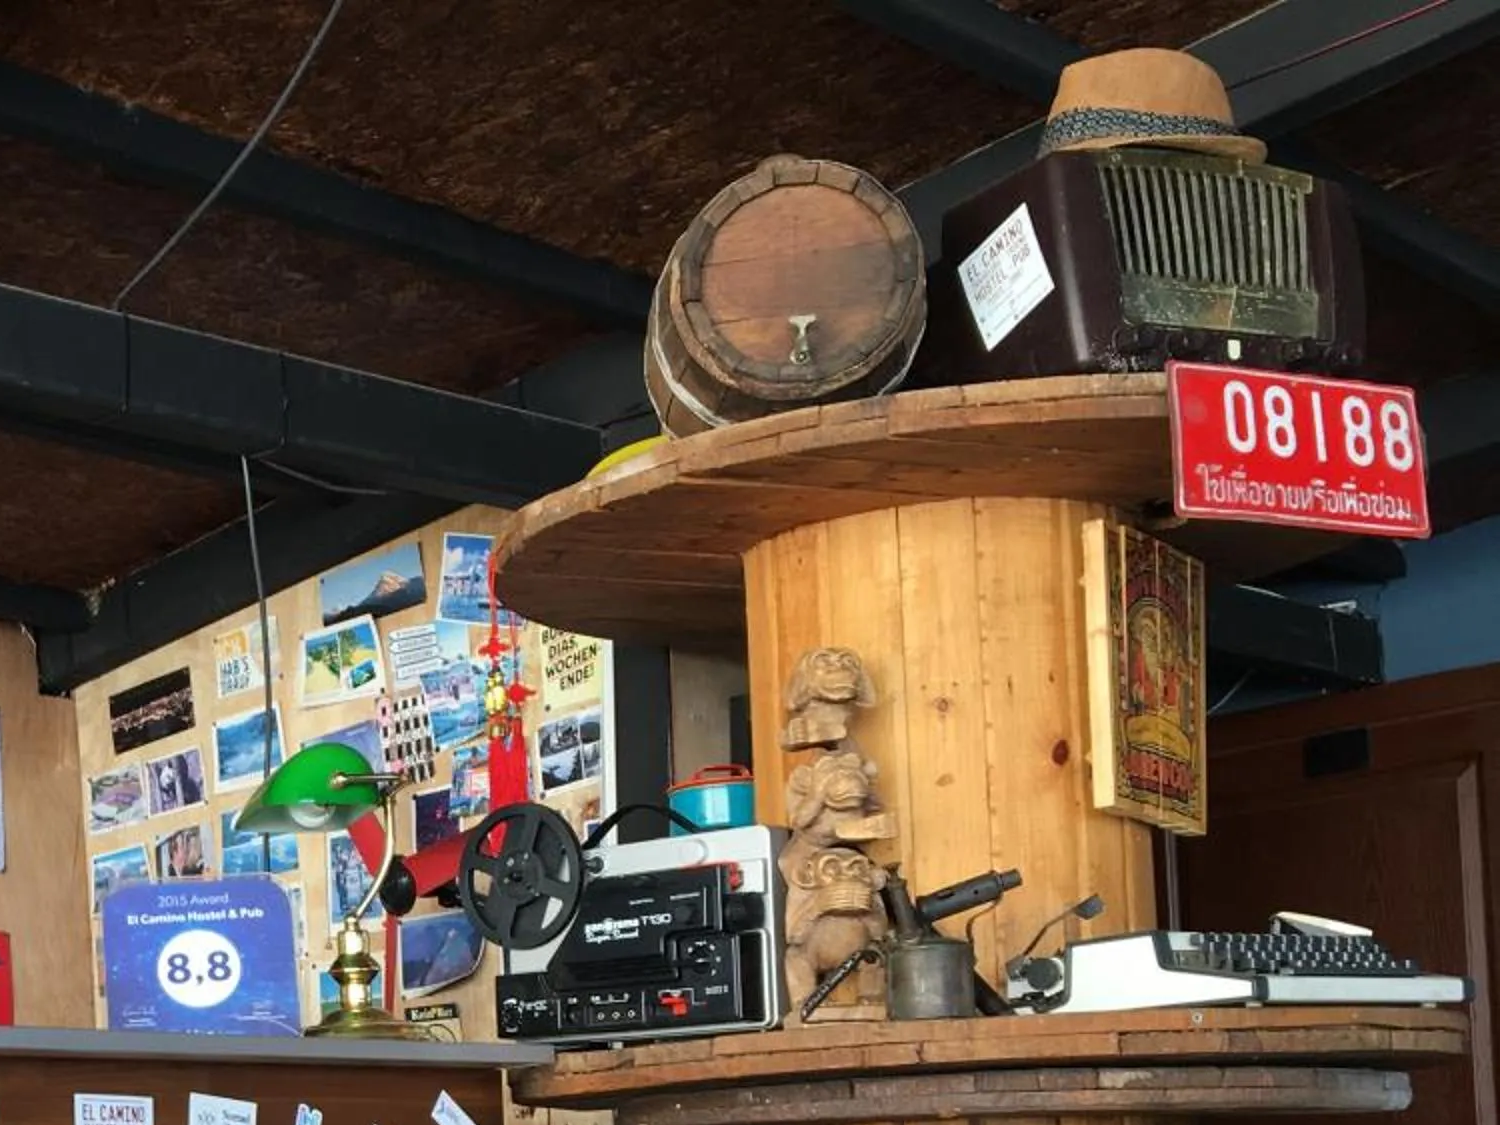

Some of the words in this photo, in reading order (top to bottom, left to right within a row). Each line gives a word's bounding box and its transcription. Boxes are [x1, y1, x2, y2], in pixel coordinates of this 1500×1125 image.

[1223, 380, 1415, 472] 08188
[140, 912, 186, 925] Camino
[228, 908, 238, 919] &
[240, 907, 264, 919] Pub
[167, 950, 232, 986] 8,8
[82, 1104, 96, 1121] EL
[100, 1104, 146, 1122] CAMINO
